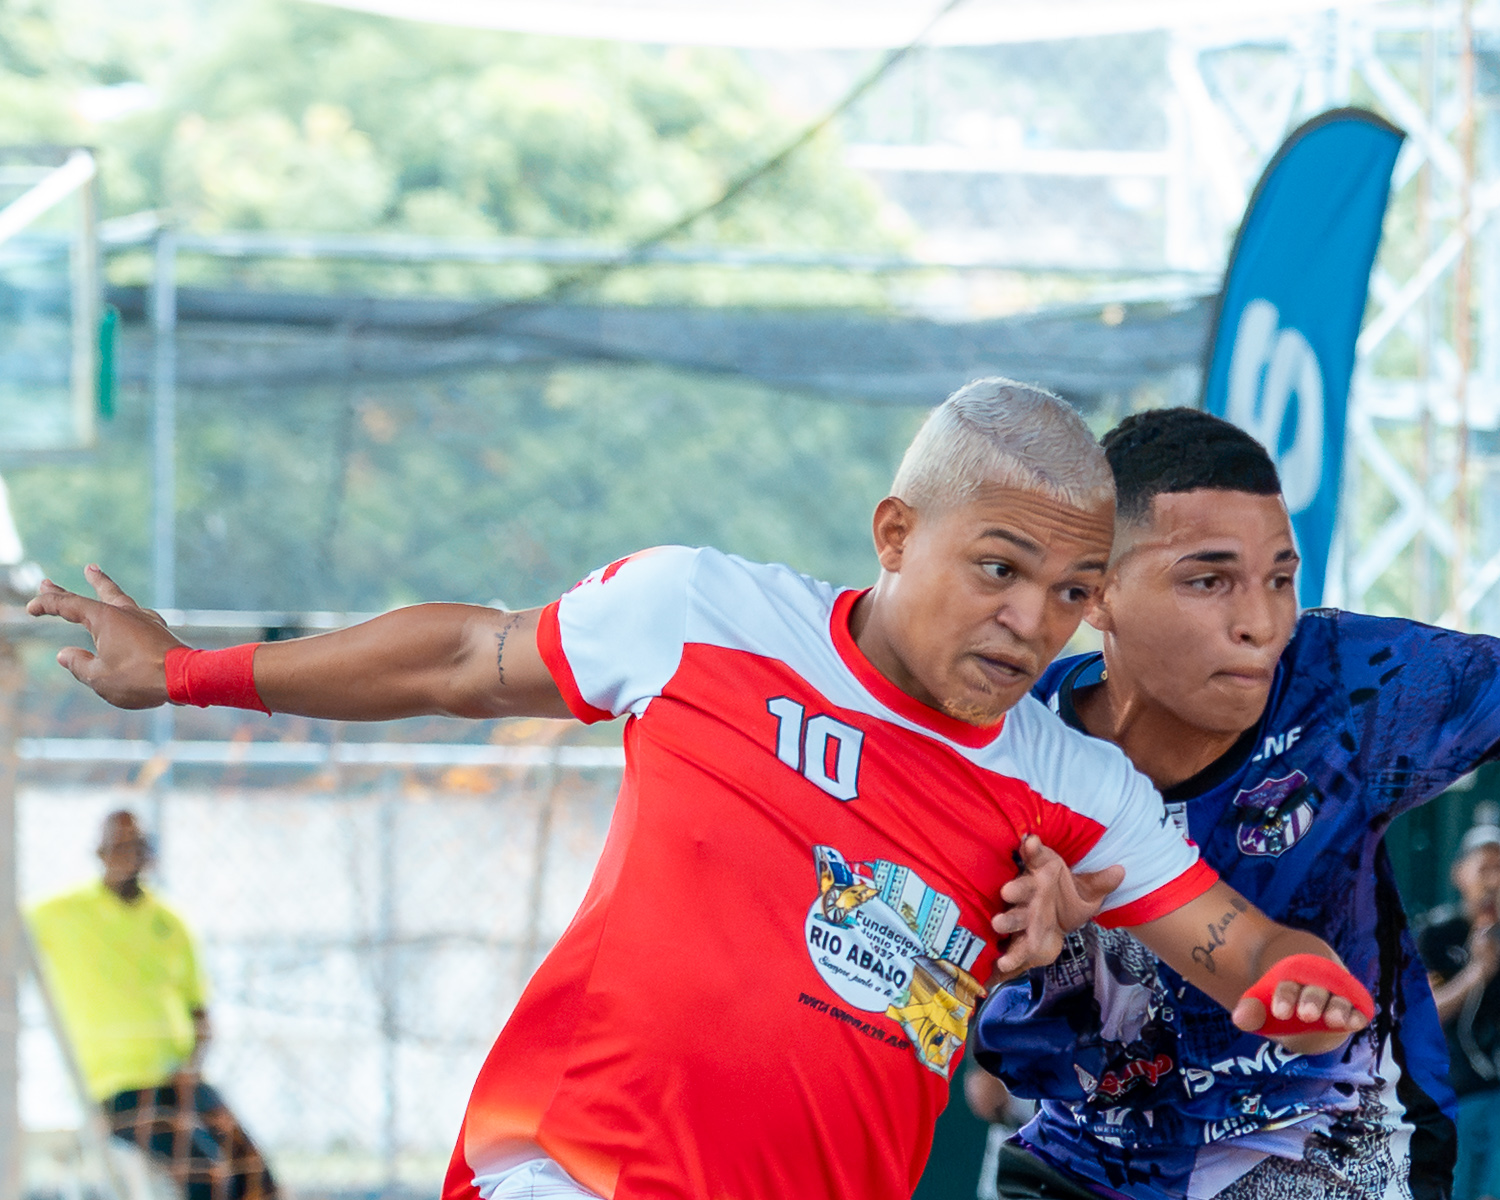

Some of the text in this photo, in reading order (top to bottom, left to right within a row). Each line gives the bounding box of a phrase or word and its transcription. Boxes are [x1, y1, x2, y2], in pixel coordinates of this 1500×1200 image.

[766, 695, 865, 803] 10
[810, 925, 907, 989] RIO ABAJO
[895, 946, 908, 958] 18
